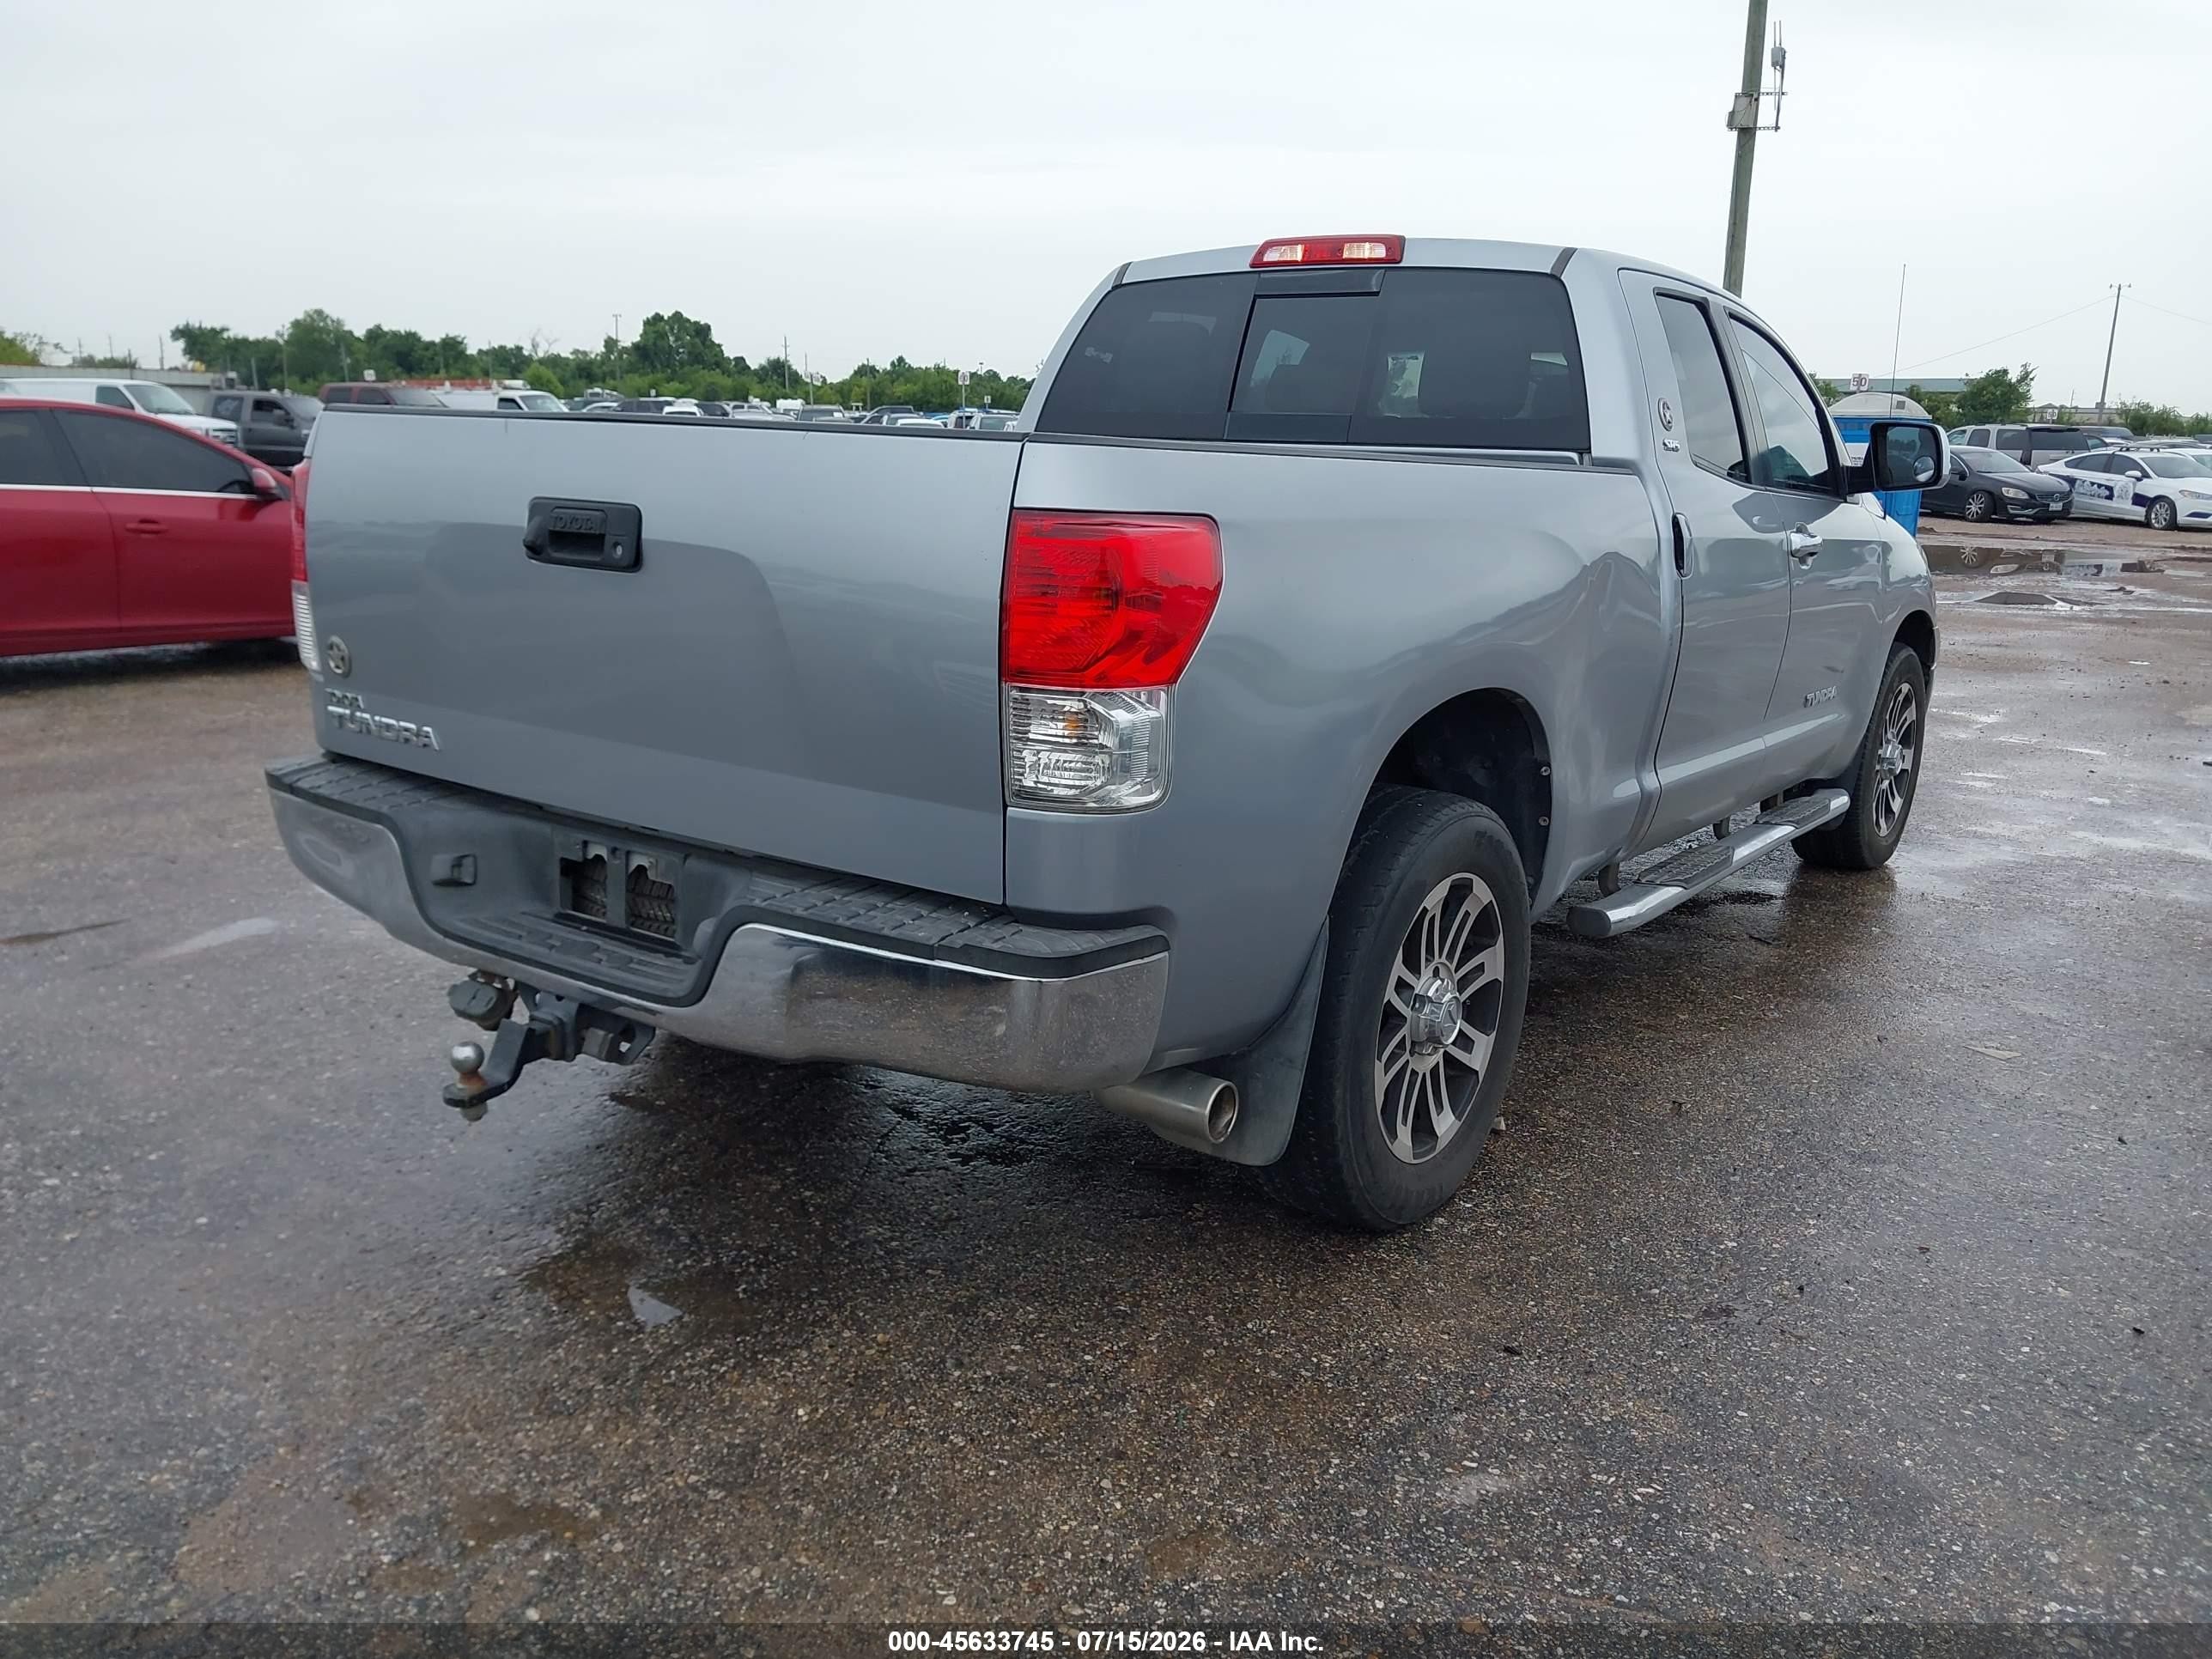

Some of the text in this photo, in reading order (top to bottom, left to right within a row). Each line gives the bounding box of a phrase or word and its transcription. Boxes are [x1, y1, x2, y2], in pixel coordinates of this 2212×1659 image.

[1852, 377, 1867, 386] 50
[550, 514, 604, 534] TOYOTA
[1805, 685, 1837, 707] TUNDRA
[326, 706, 441, 751] TUNDRA
